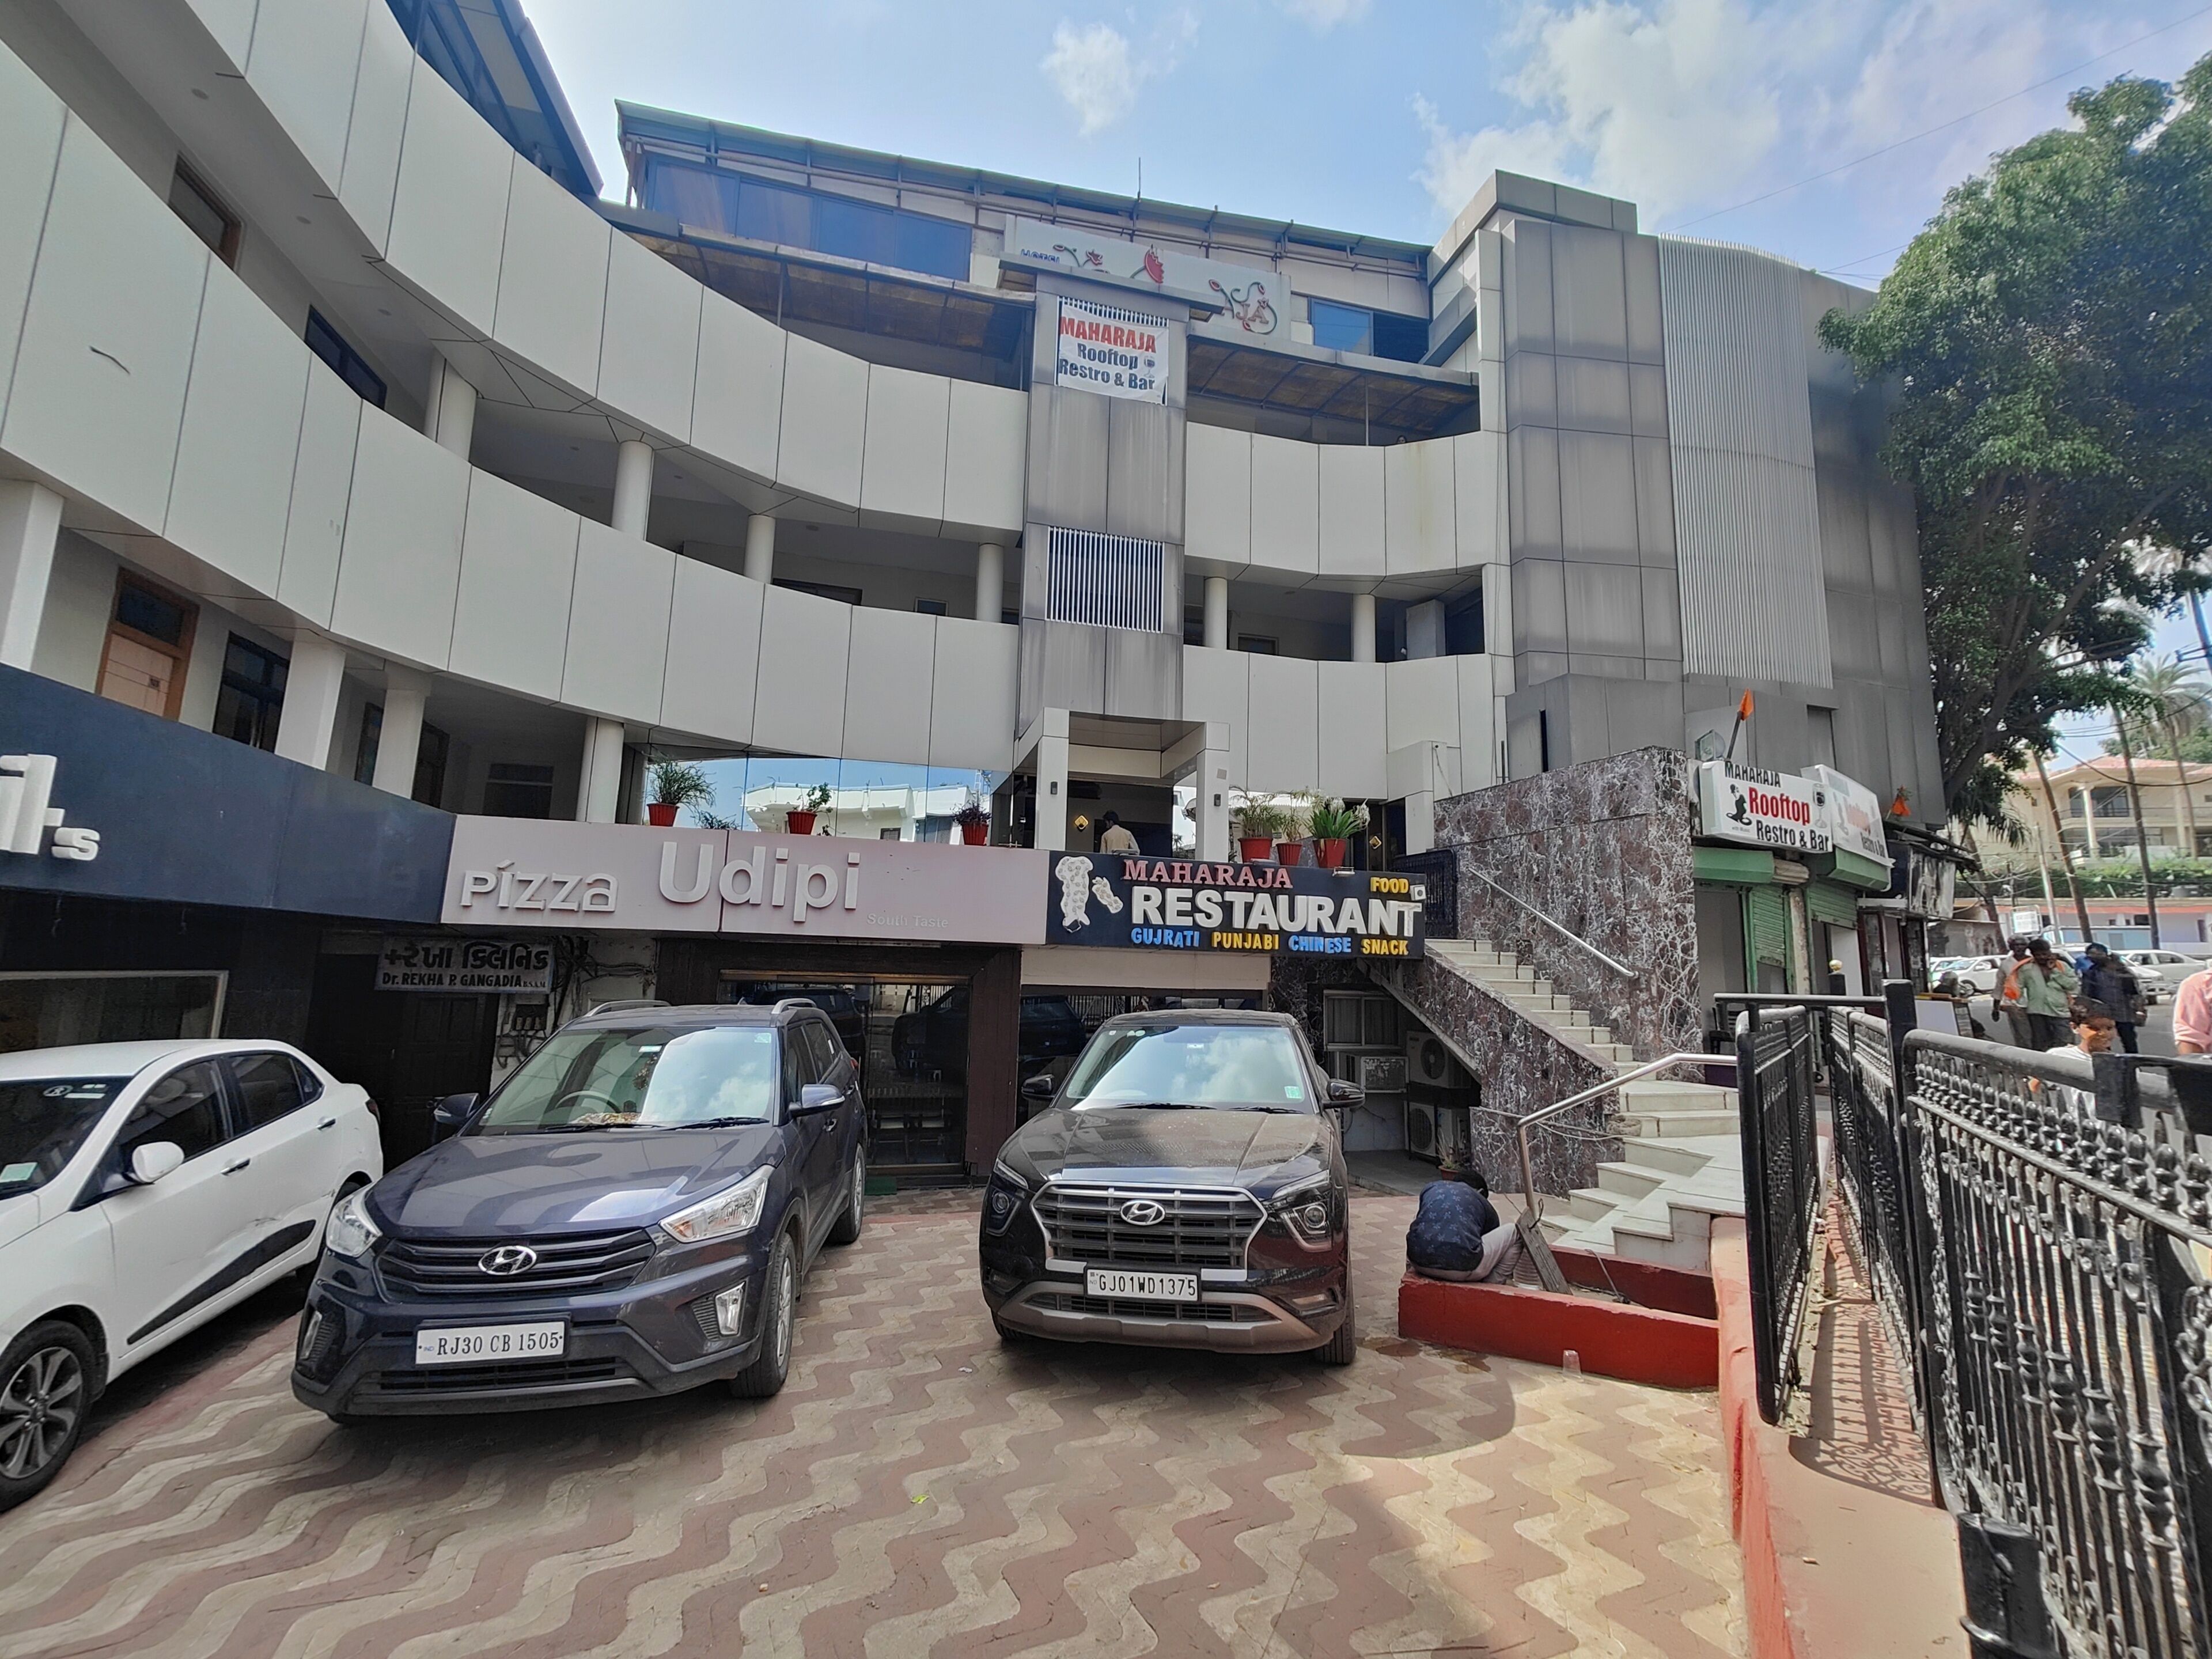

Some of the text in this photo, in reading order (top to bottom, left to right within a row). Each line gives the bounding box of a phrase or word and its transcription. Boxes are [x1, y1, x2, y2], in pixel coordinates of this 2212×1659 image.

[1060, 316, 1156, 353] MAHARAJA
[1077, 343, 1138, 370] Rooftop
[1059, 359, 1155, 390] Restro & Bar
[1725, 761, 1781, 787] MAHARAJA
[1749, 786, 1810, 826] Rooftop
[1756, 820, 1829, 851] Restro & Bar
[659, 841, 861, 922] Udipi
[1122, 859, 1293, 889] MAHARAJA
[1370, 876, 1410, 895] FOOD
[867, 913, 949, 927] South Taste
[1131, 885, 1422, 937] RESTAURANT
[1131, 927, 1409, 956] GUJRATI PUNJABI CHINESE SNACK
[382, 972, 399, 986] Dr.
[402, 972, 444, 986] REKHA
[460, 974, 522, 987] GANGADIA
[1099, 1274, 1196, 1296] GJ01WD1375
[437, 1331, 559, 1355] RJ30 CB 1505
